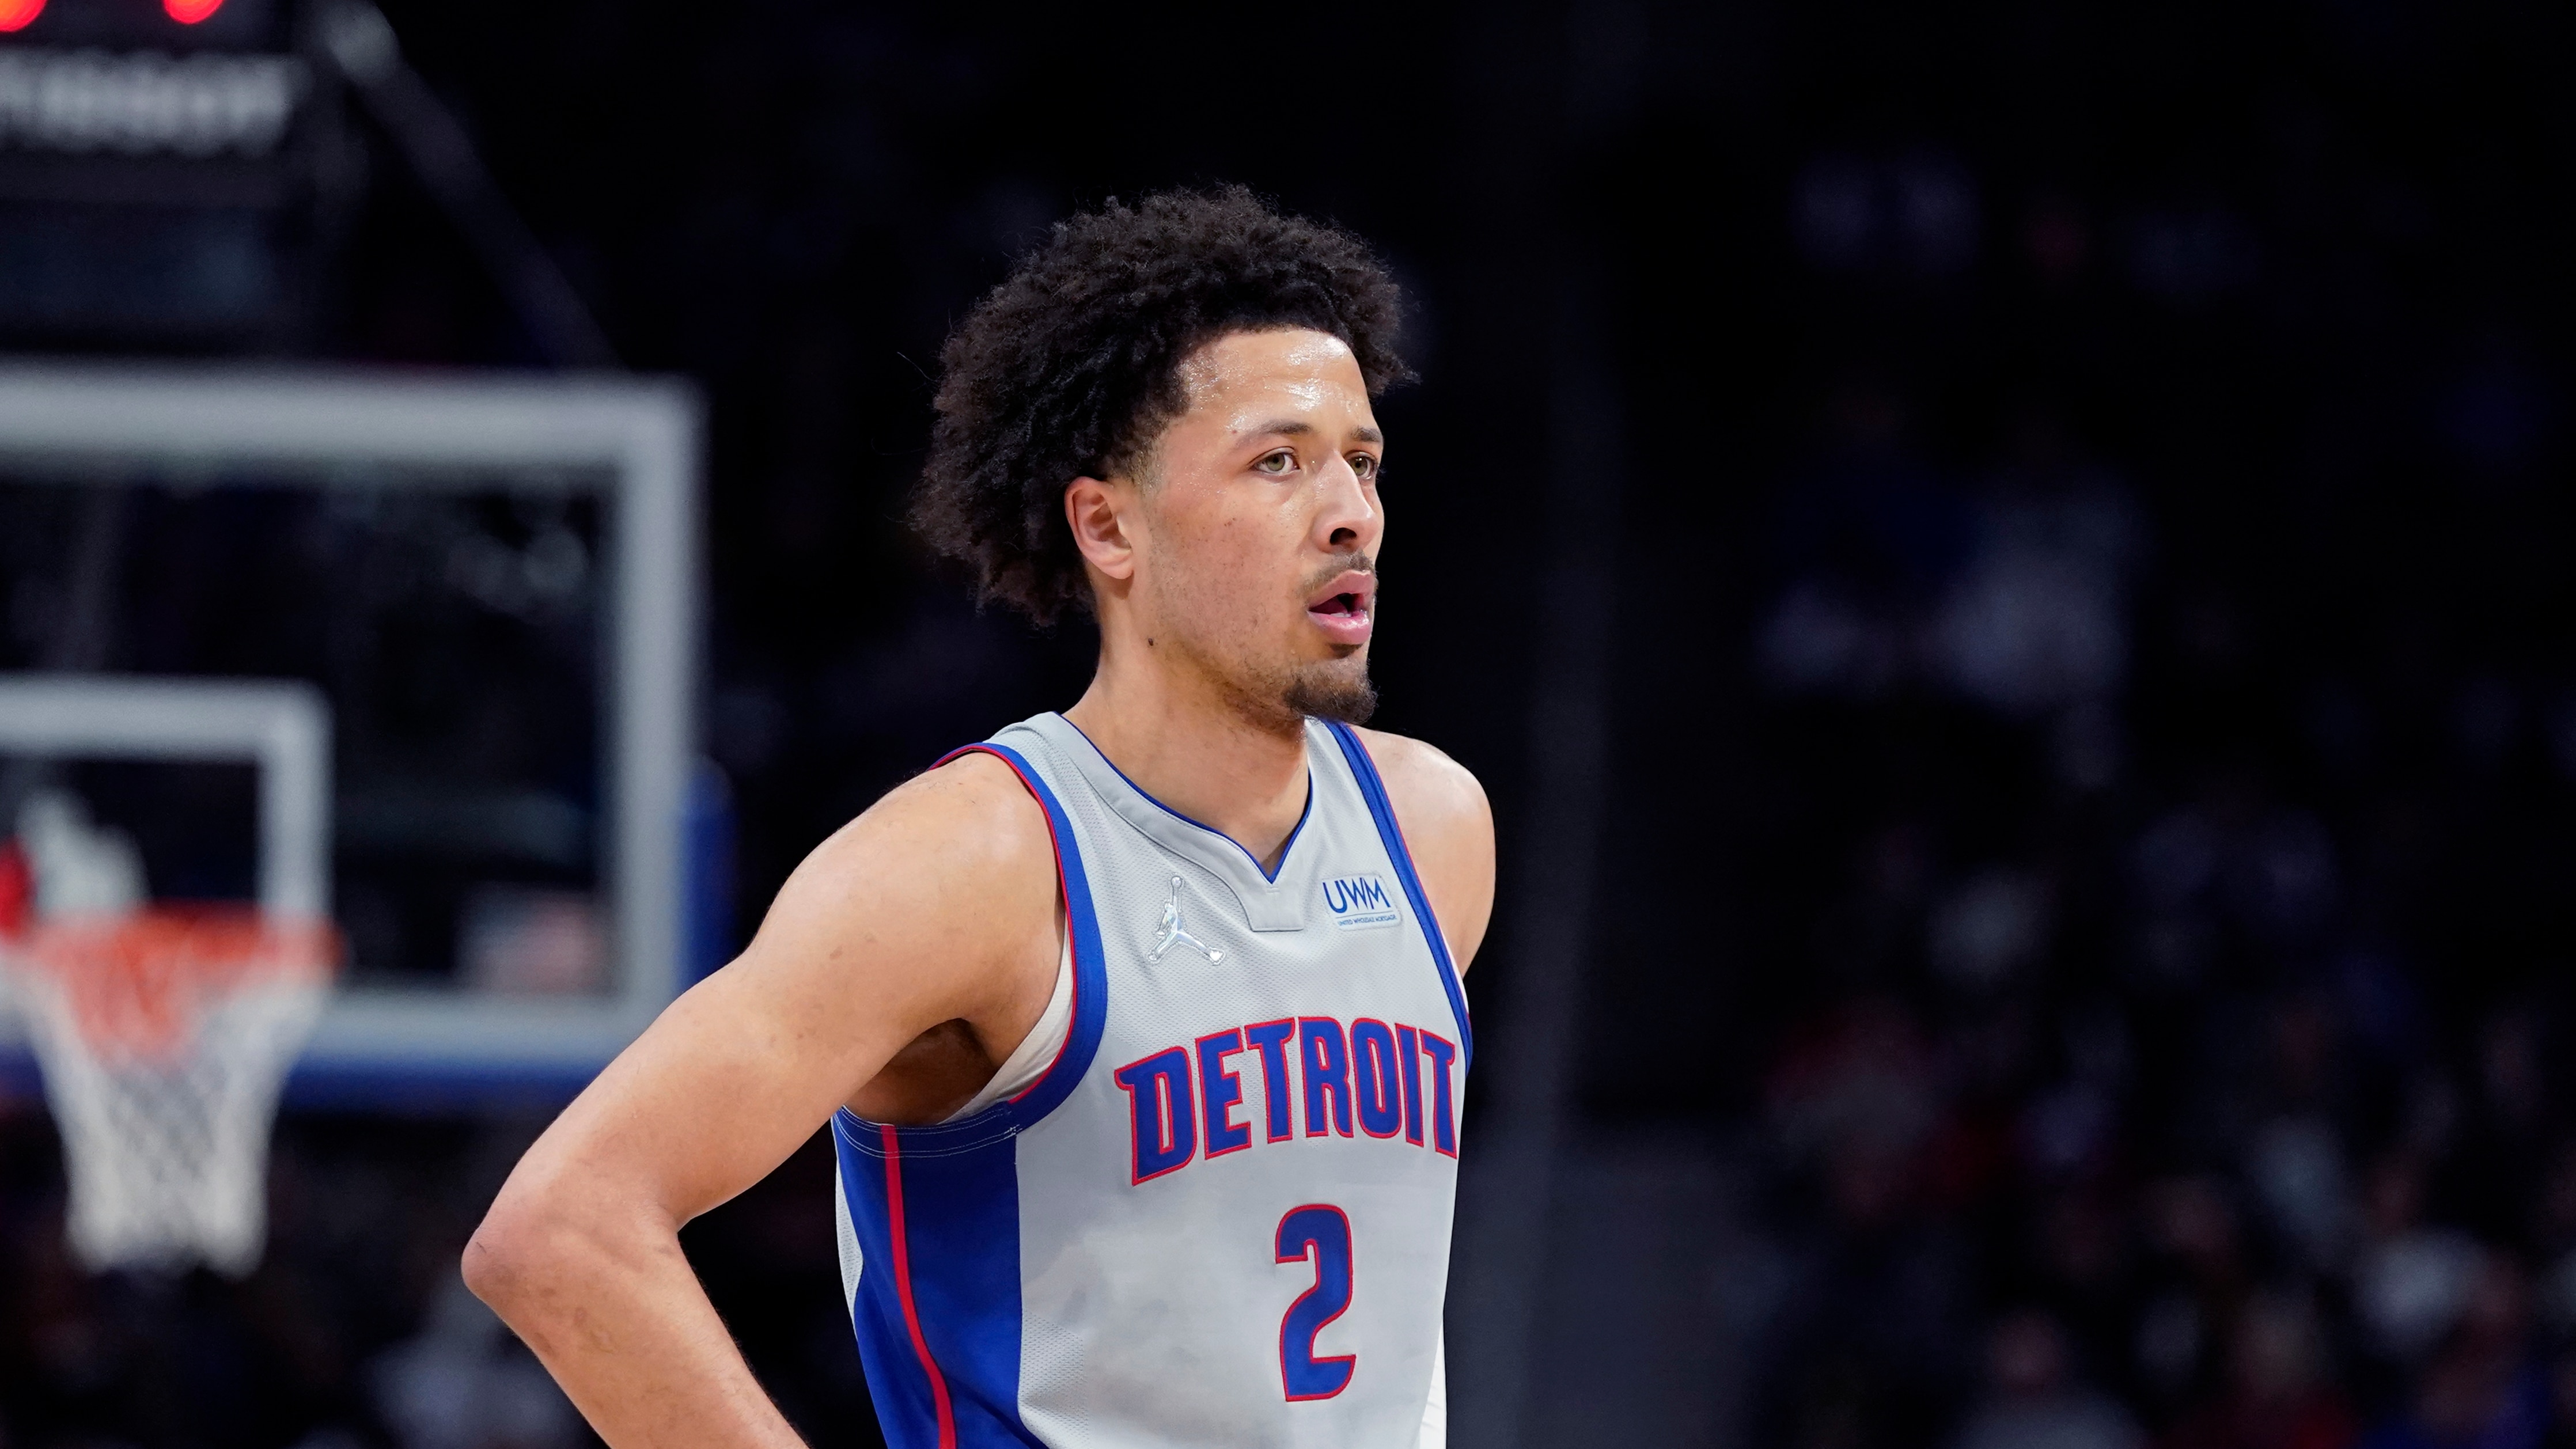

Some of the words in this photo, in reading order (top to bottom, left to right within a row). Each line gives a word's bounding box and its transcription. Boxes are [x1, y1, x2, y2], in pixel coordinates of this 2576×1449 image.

[1323, 877, 1391, 913] UWM
[1114, 1016, 1457, 1186] DETROIT
[1275, 1204, 1356, 1402] 2
